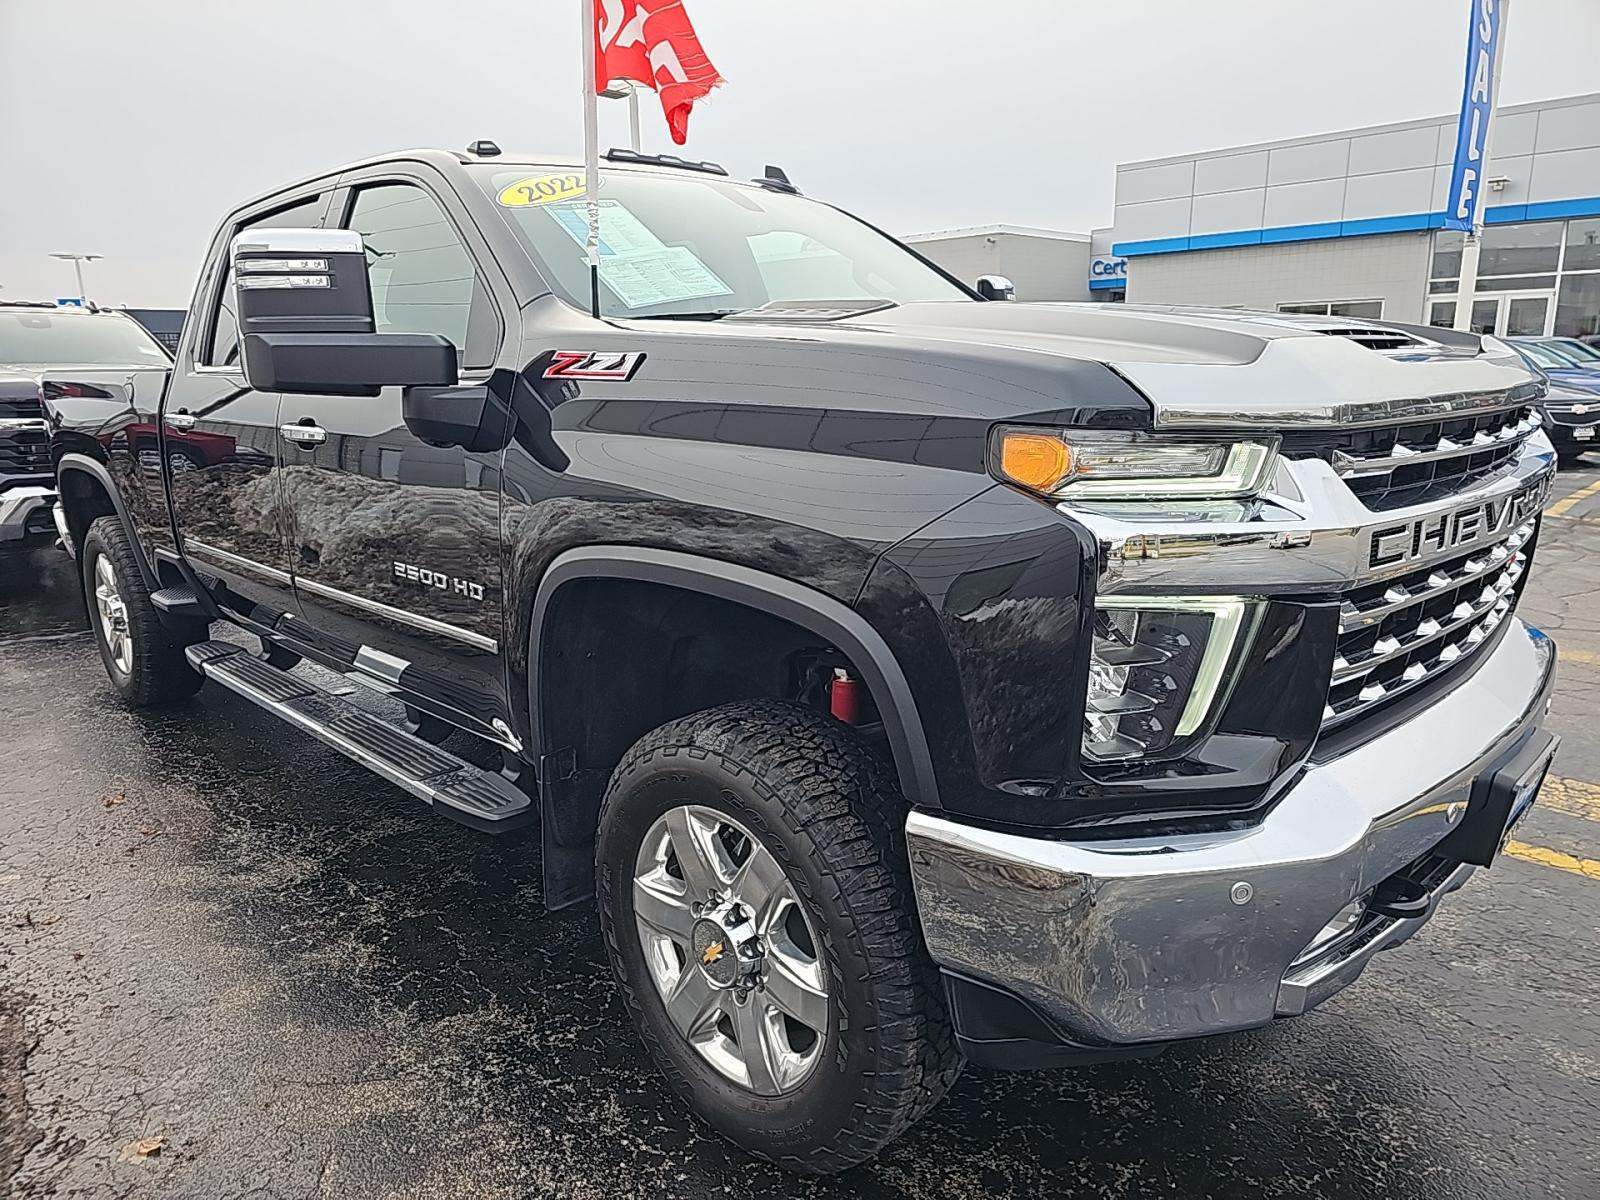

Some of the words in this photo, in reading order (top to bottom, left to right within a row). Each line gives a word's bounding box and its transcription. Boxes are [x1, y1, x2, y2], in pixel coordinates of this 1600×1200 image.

[1457, 0, 1493, 219] SALE
[517, 175, 586, 203] 2022
[541, 351, 646, 381] Z71
[393, 561, 448, 590] 2500
[453, 577, 486, 601] HD
